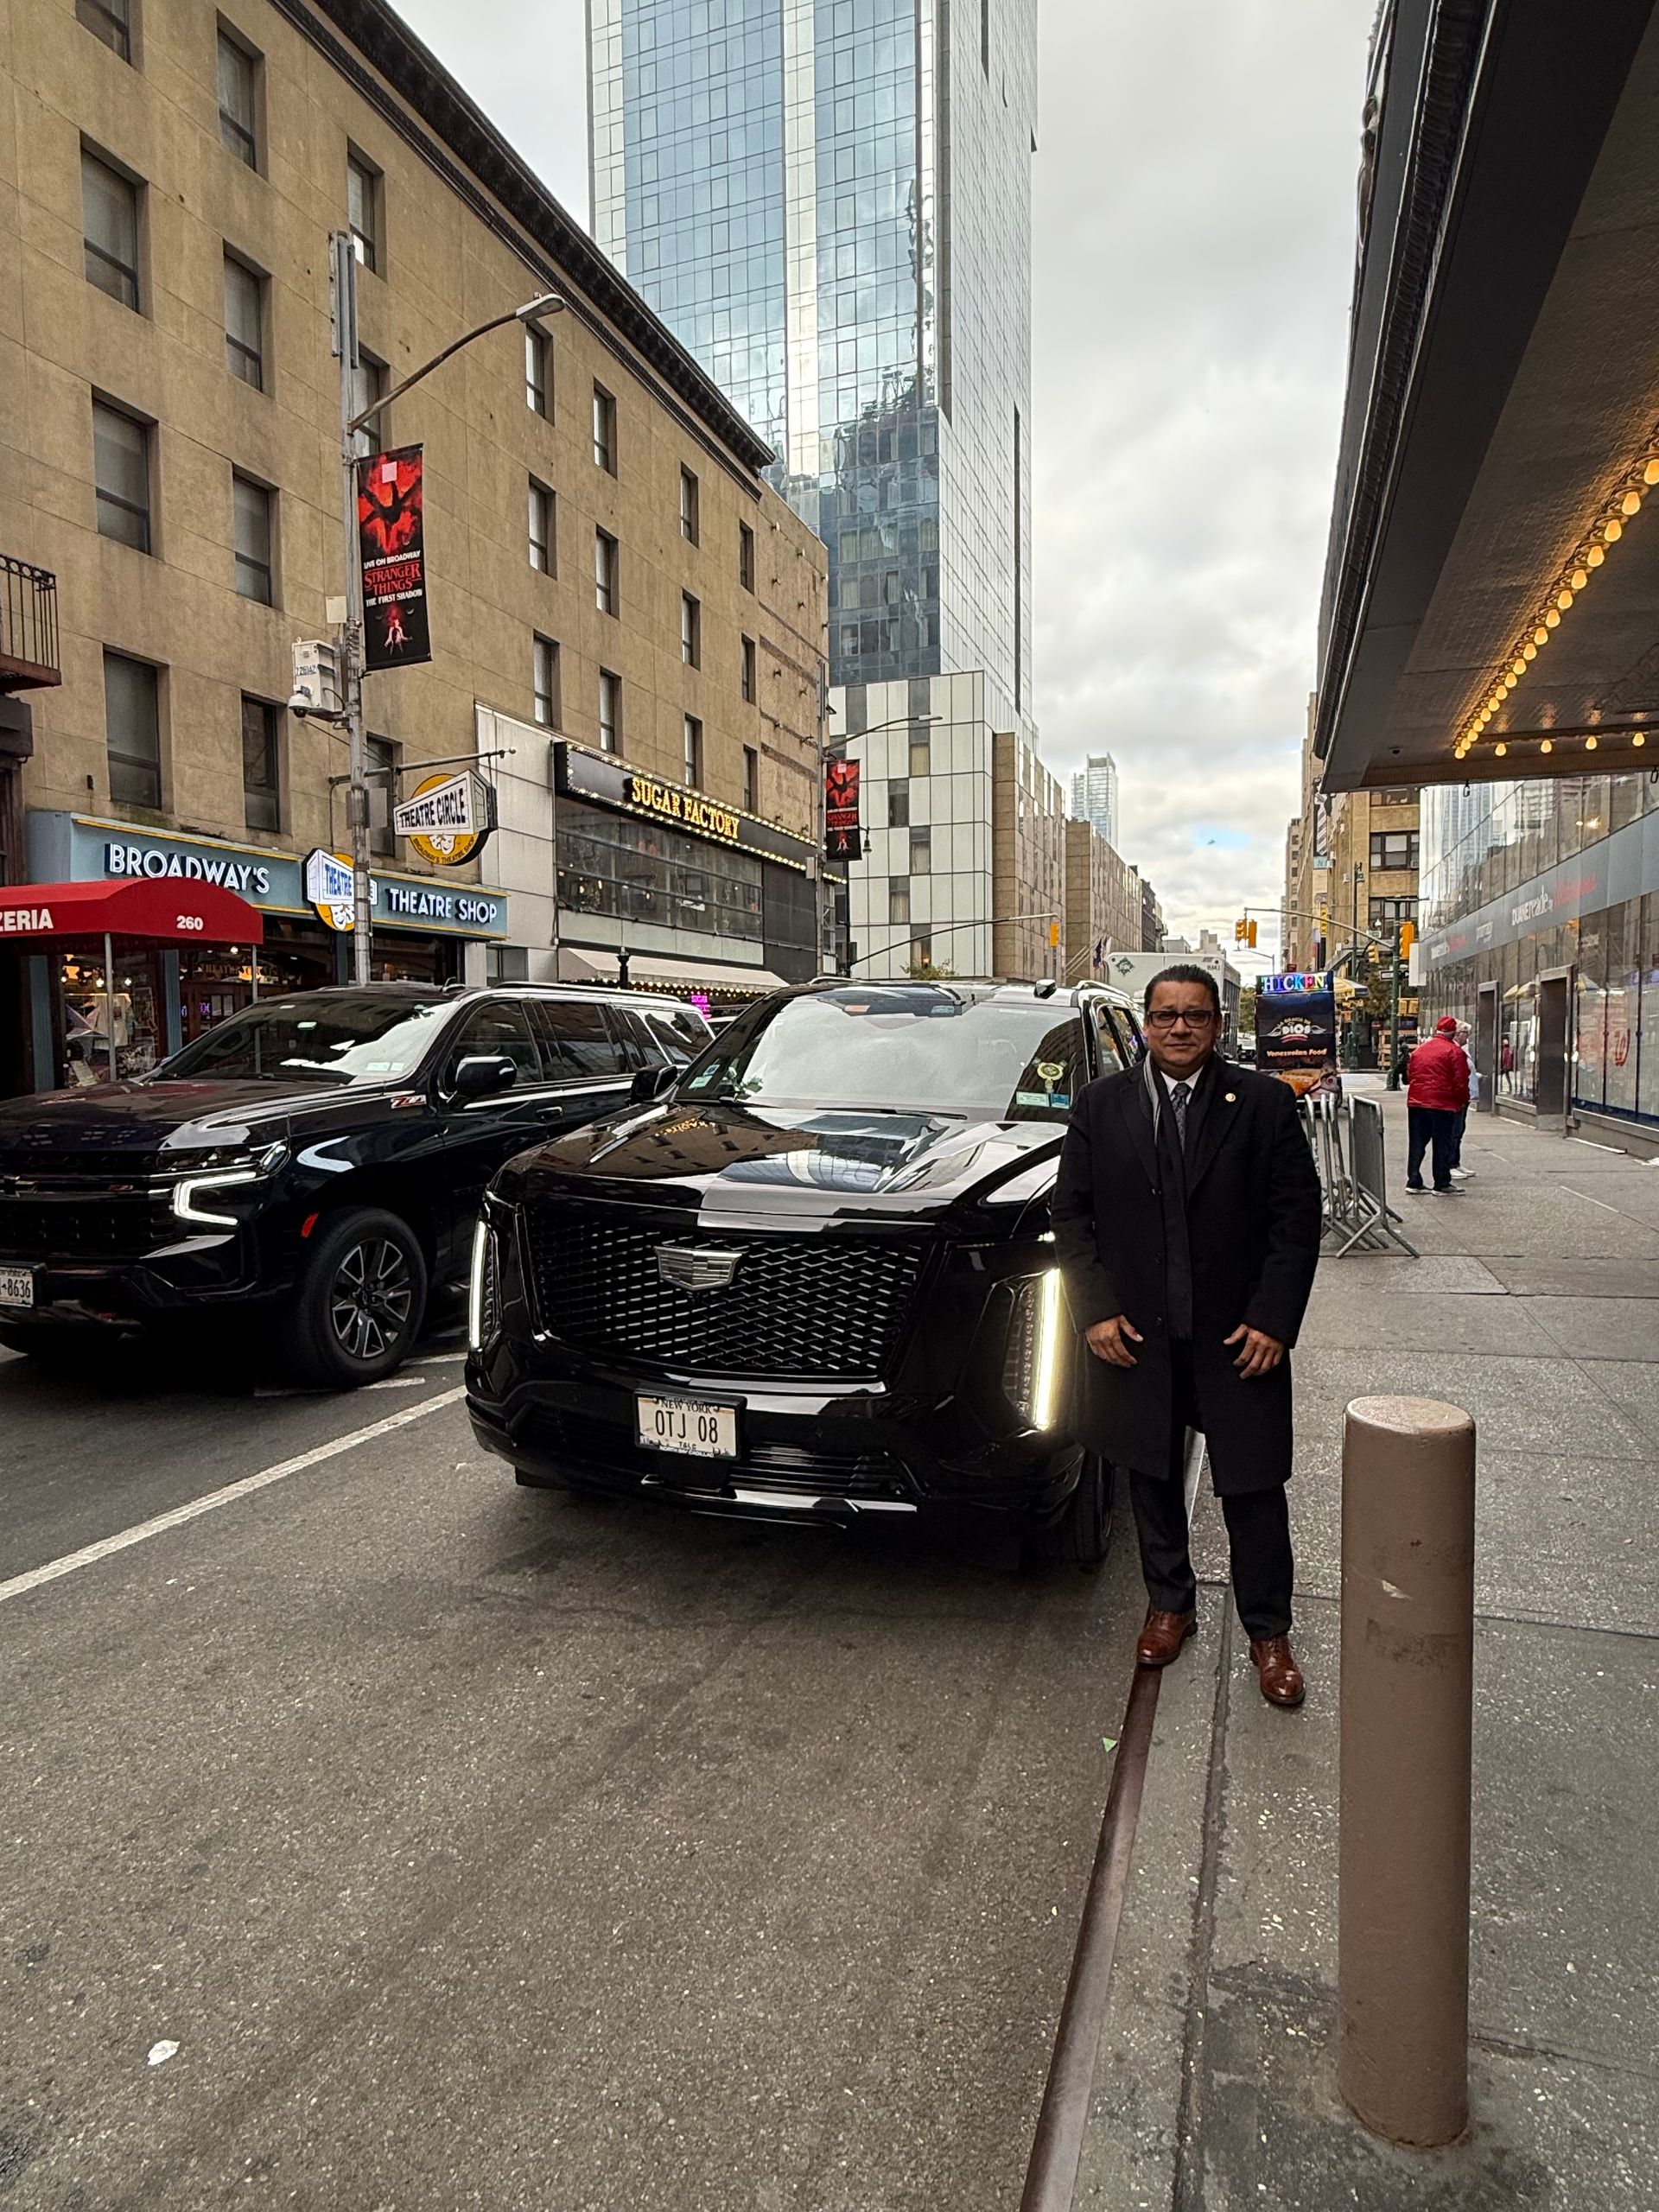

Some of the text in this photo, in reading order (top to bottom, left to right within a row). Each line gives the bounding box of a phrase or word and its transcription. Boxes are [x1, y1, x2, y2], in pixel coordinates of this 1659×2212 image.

[387, 550, 421, 563] BROADWAY
[365, 563, 422, 588] STRANGER
[372, 578, 413, 596] THINGS
[365, 589, 423, 607] THE FIRST SHADOW
[399, 788, 466, 828] THEATRE CIRCLE
[632, 777, 740, 839] SUGAR FACTORY
[413, 838, 440, 863] BROADWAY'S
[442, 849, 464, 863] THEATRE
[109, 843, 270, 893] BROADWAY'S
[325, 864, 353, 896] THEATRE
[389, 888, 452, 918] THEATRE
[458, 899, 498, 924] SHOP
[176, 915, 204, 931] 260
[661, 1400, 712, 1414] NEW YORK
[698, 1415, 718, 1444] 08
